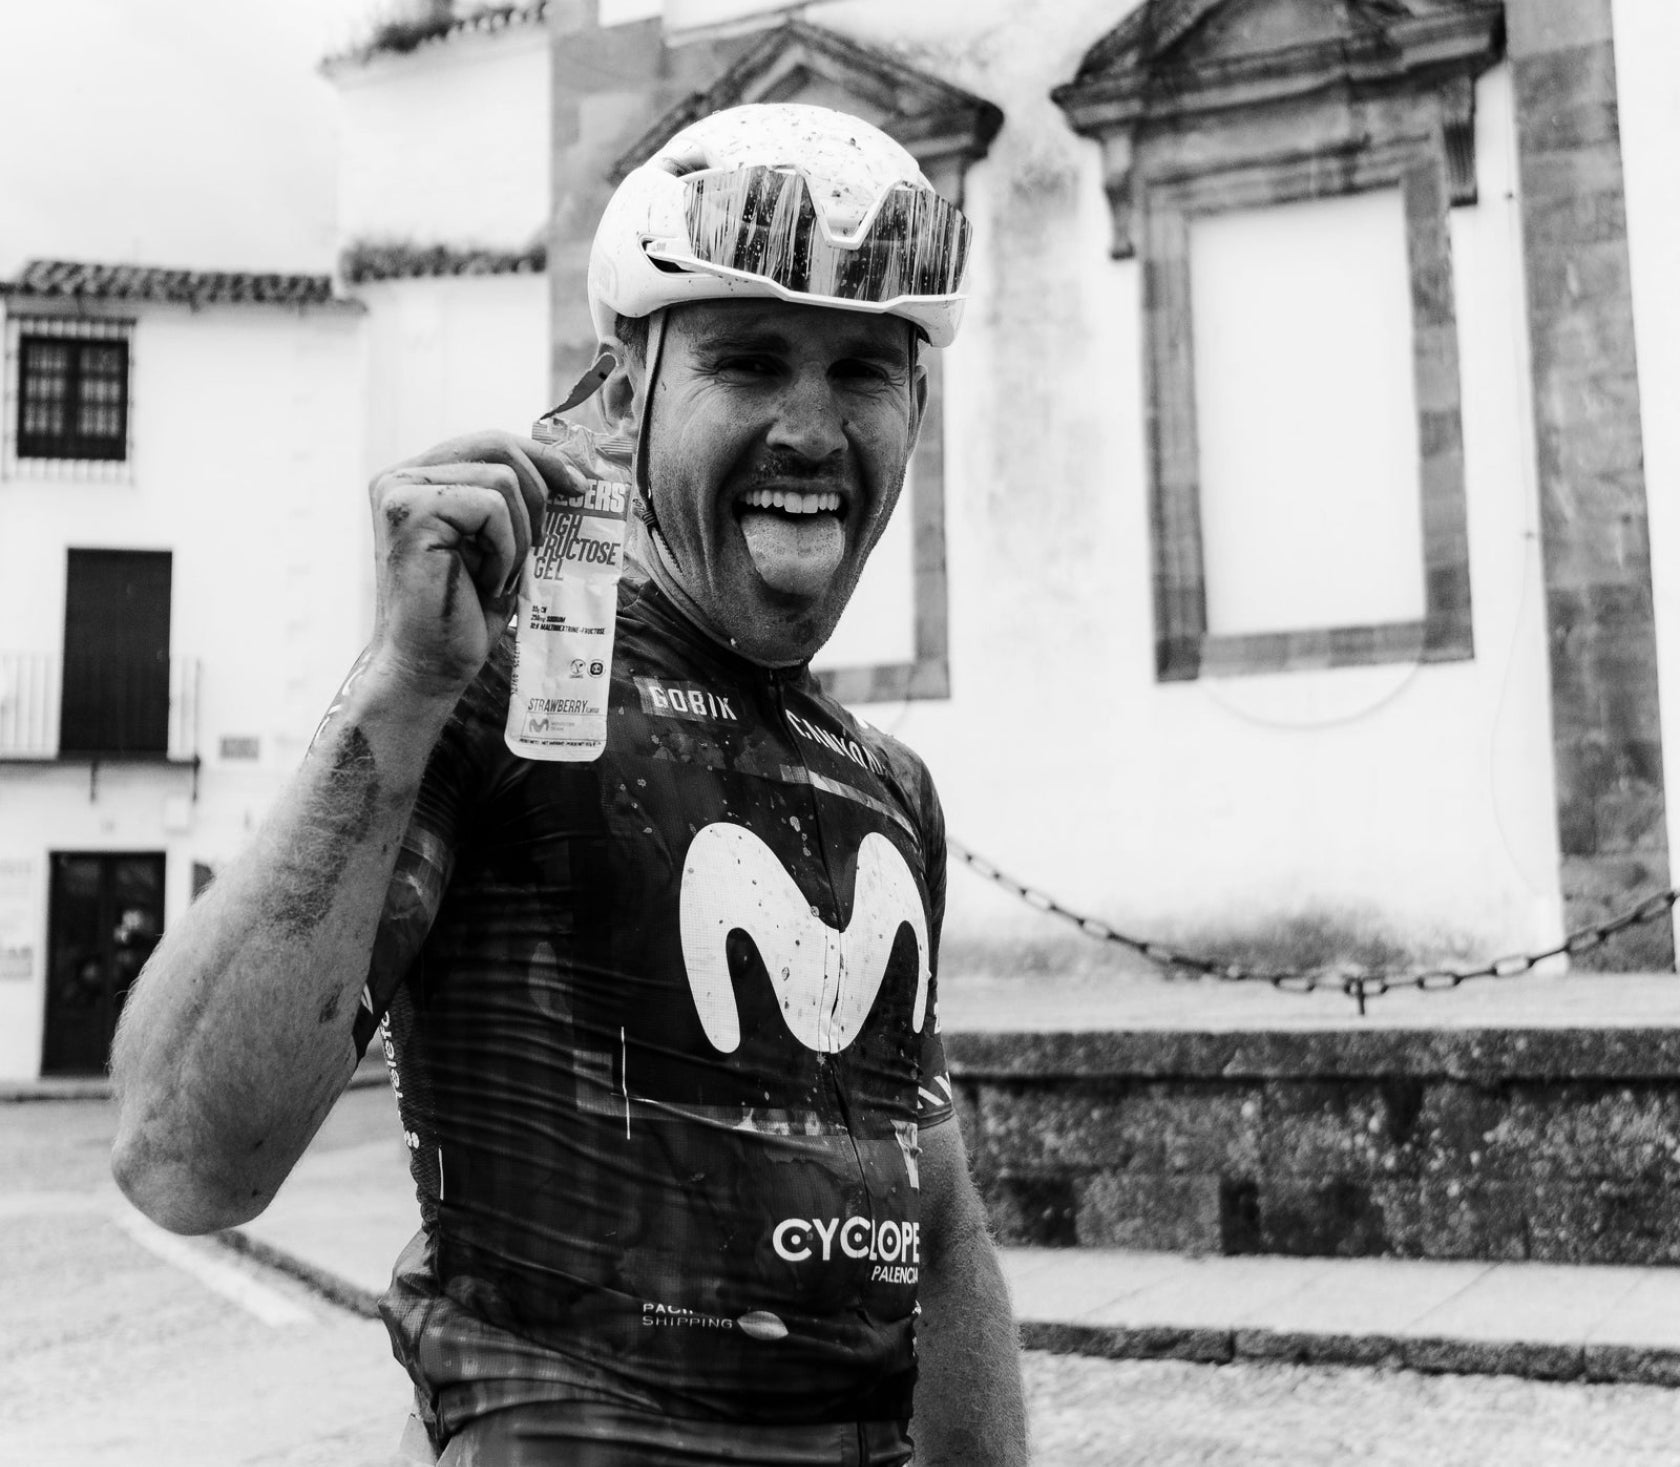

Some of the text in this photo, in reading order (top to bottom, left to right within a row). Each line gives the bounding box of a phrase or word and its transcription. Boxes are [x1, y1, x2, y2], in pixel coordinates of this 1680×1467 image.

[547, 478, 626, 513] ERS
[533, 533, 621, 566] RUCTOSE
[534, 556, 564, 581] GEL
[528, 698, 588, 713] STRAWBERRY
[650, 686, 737, 720] GOBIK
[772, 1216, 920, 1263] CYCLOPE
[642, 1315, 733, 1329] SHIPPING
